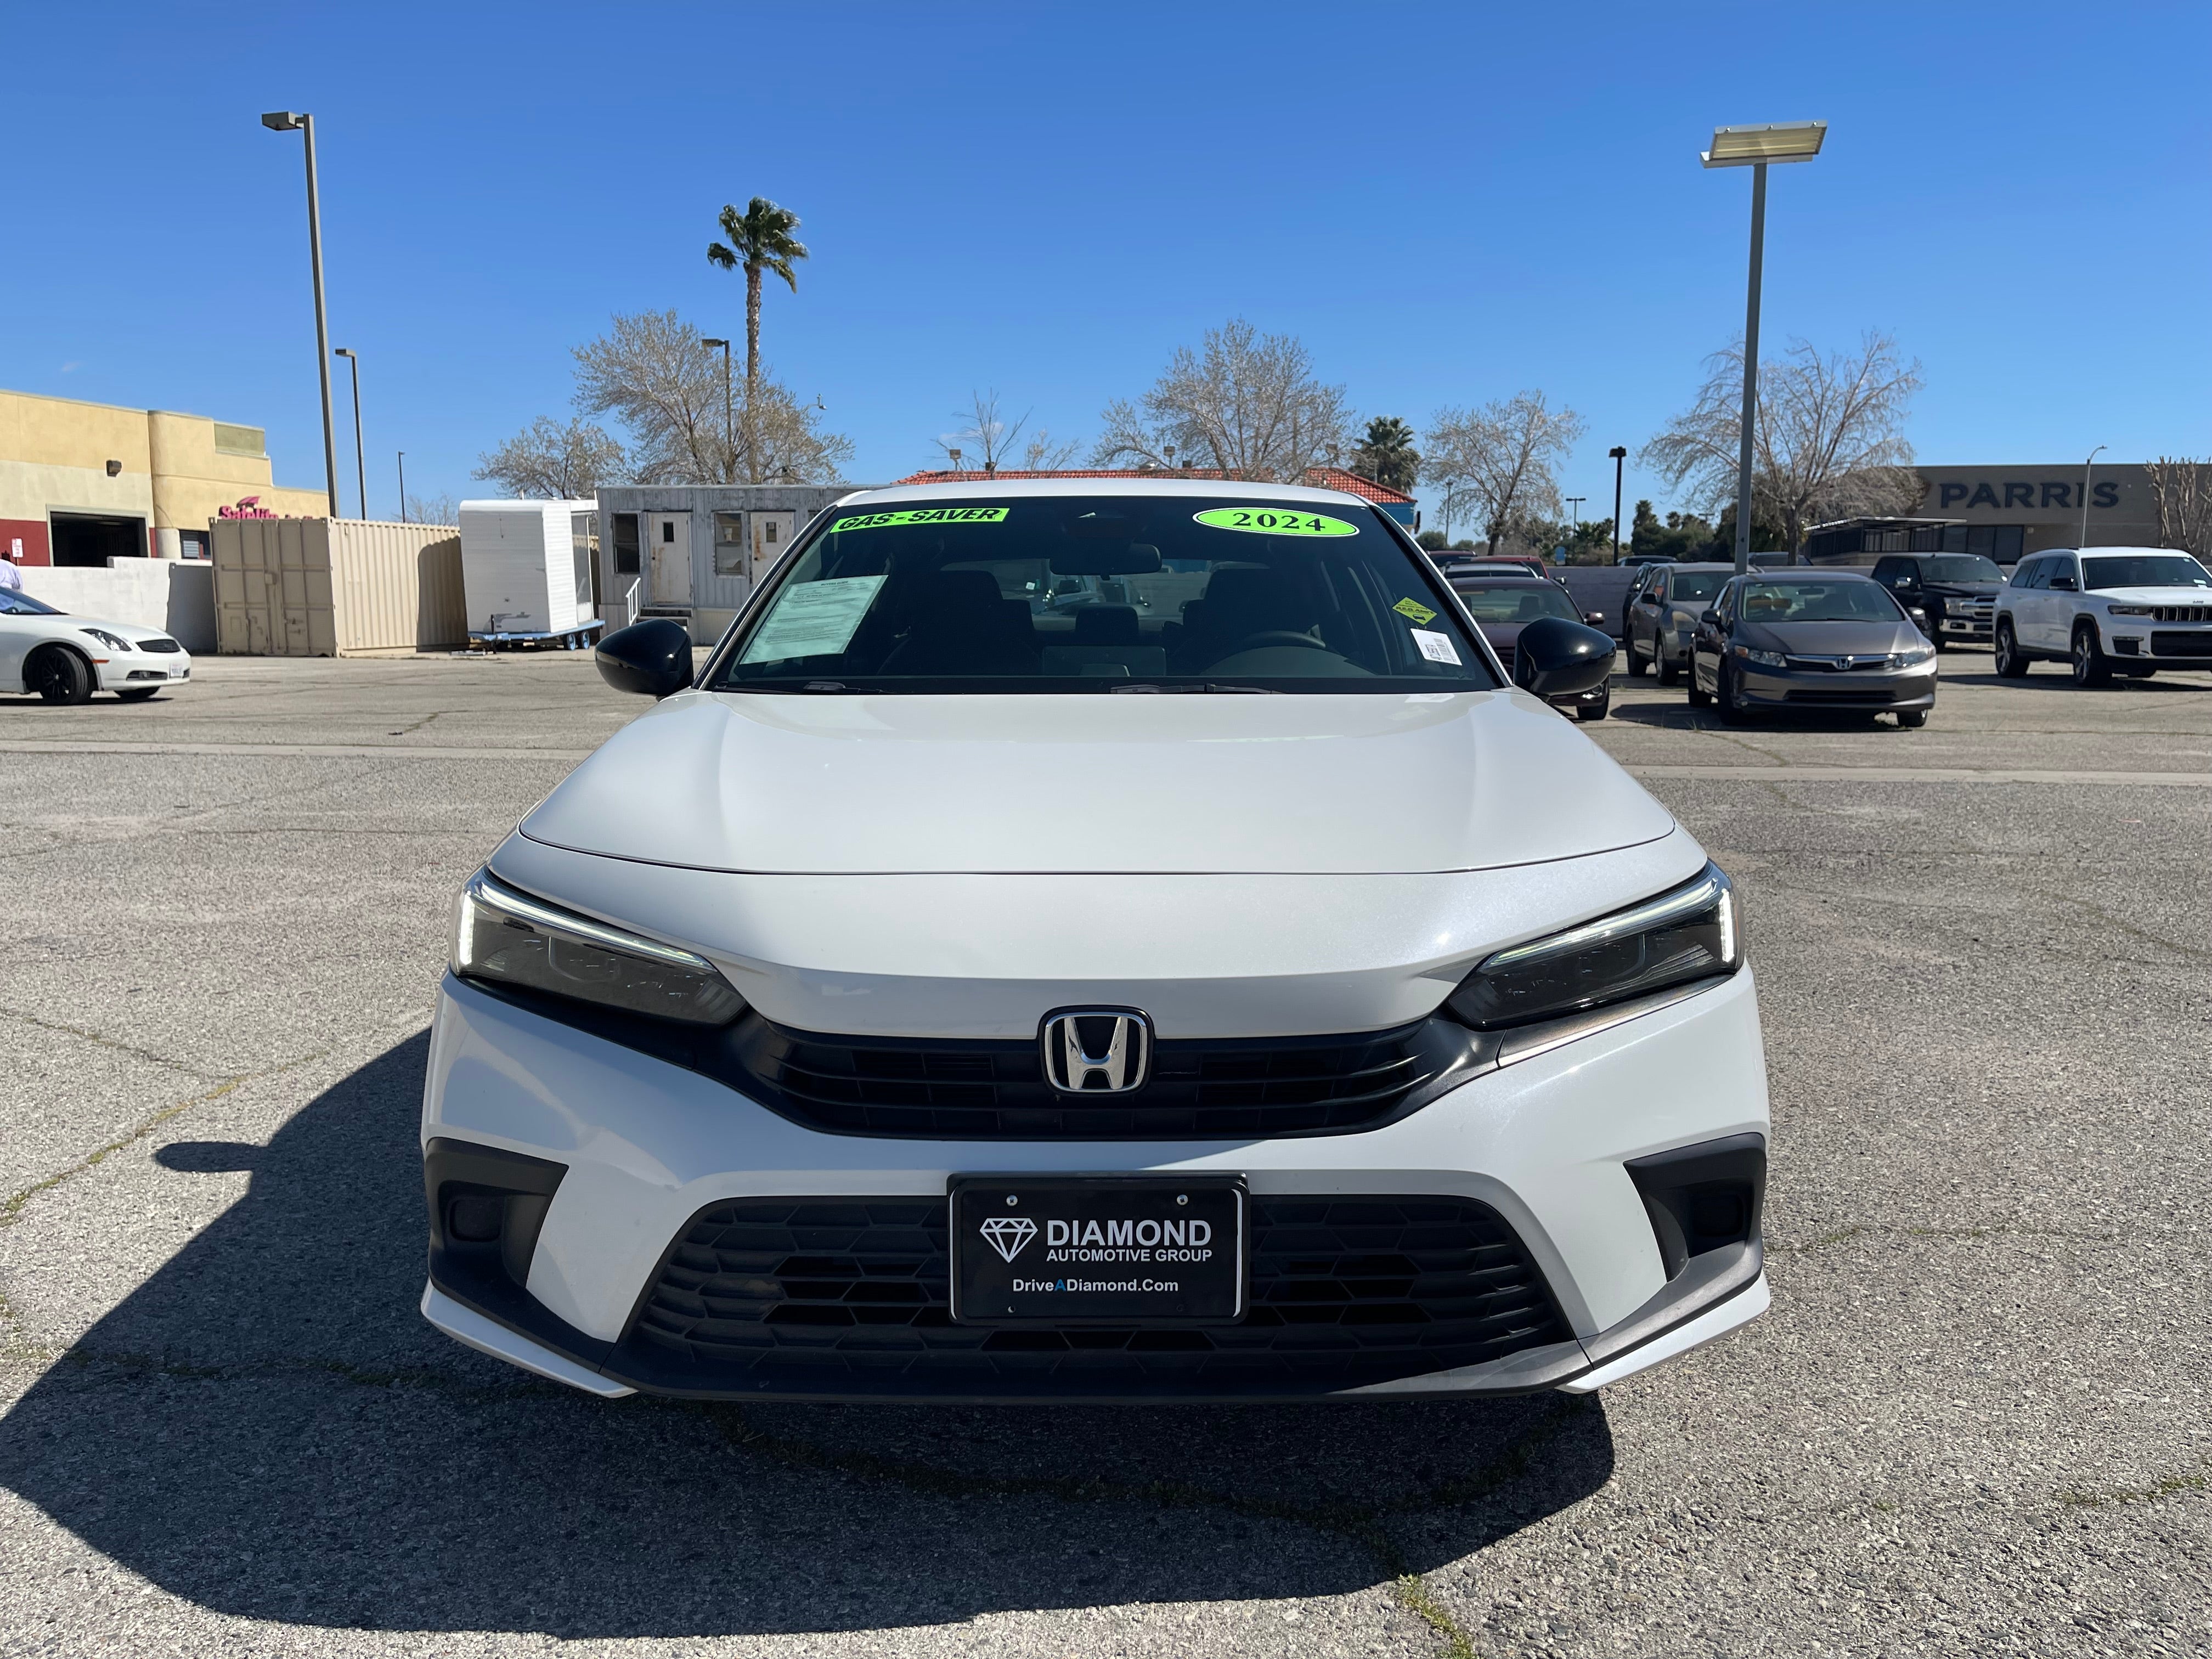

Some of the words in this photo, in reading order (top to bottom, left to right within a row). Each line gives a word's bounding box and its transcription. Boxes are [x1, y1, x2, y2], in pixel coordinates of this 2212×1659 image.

[1939, 482, 2119, 508] PARRIS
[1233, 512, 1326, 532] 2024
[1047, 1220, 1212, 1246] DIAMOND
[1046, 1249, 1150, 1262] AUTOMOTIVE
[1155, 1249, 1212, 1262] GROUP
[1013, 1279, 1178, 1292] DriveADiamond.Com
